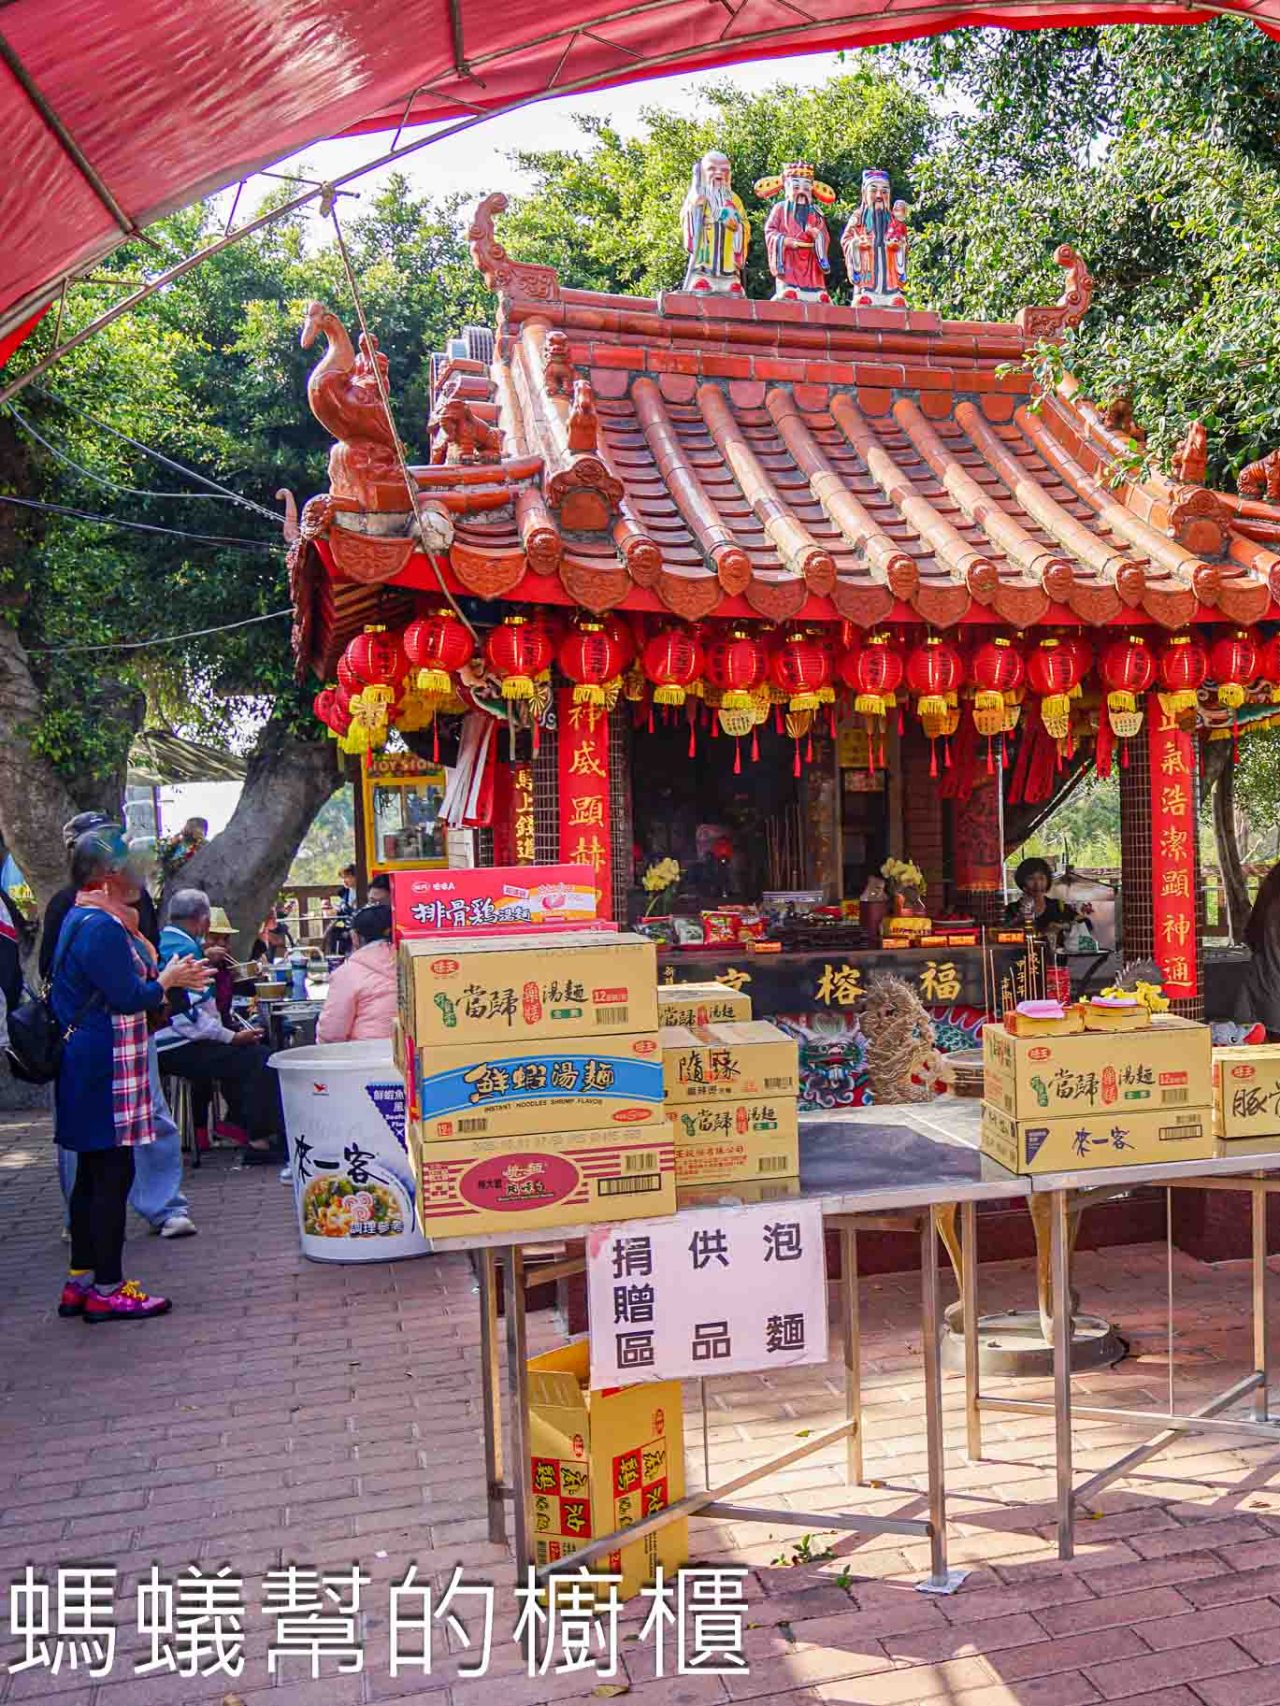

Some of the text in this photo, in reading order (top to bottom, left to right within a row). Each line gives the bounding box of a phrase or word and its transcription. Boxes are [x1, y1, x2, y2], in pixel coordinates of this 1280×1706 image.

[464, 1058, 615, 1105] 鮮蝦湯麵
[1071, 1125, 1136, 1158] 來一客
[611, 1236, 656, 1370] 捐贈區
[688, 1229, 732, 1361] 供品
[762, 1221, 806, 1354] 泡麵
